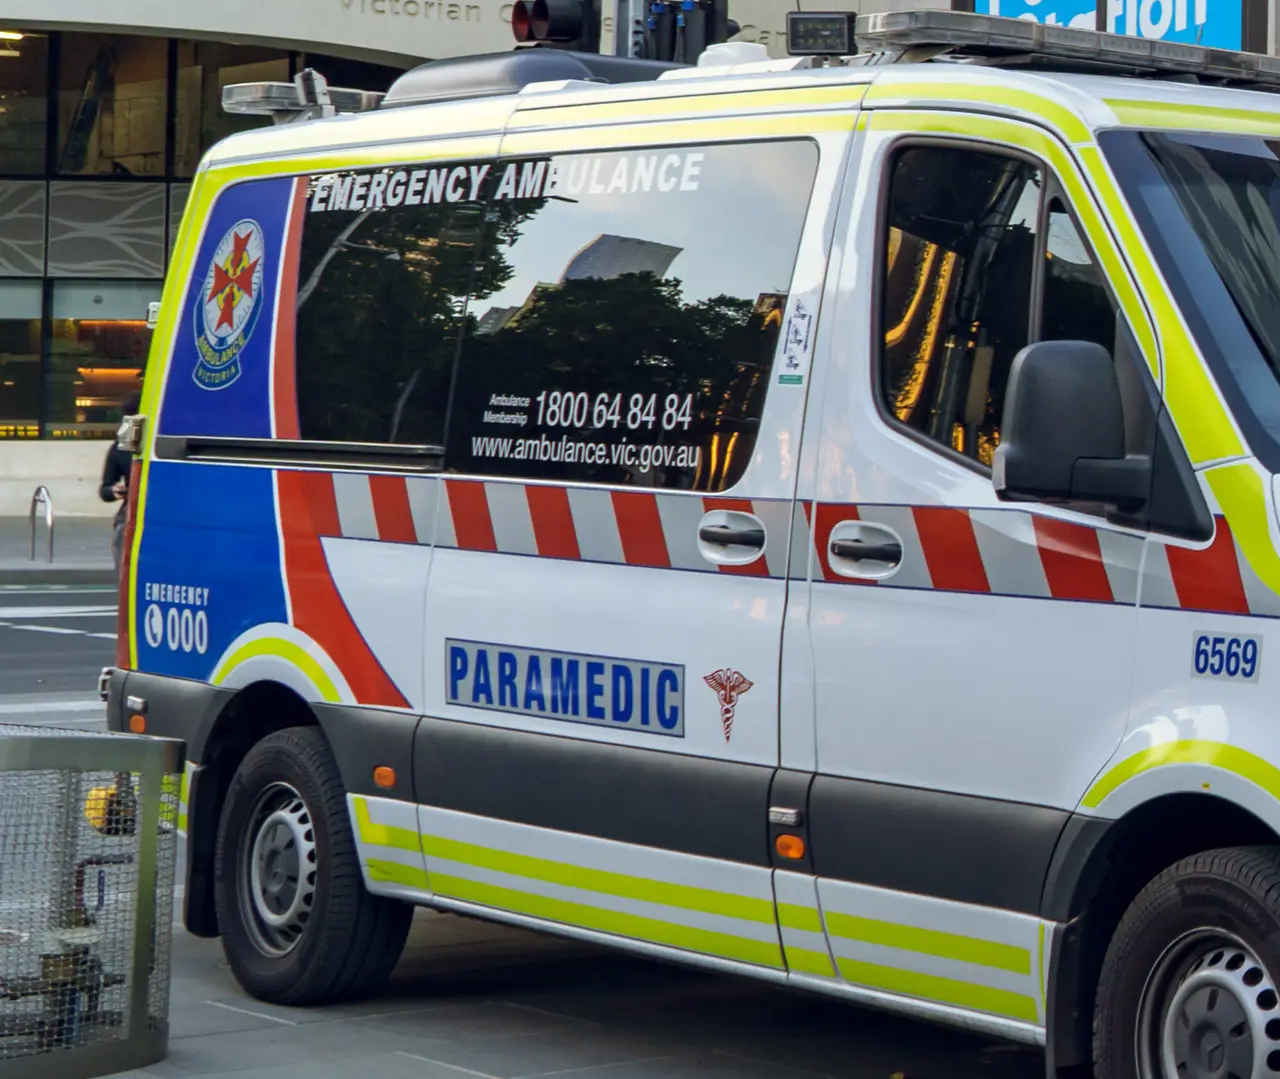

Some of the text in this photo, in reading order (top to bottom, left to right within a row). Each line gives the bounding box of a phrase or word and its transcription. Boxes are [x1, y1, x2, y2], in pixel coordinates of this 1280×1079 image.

[310, 152, 706, 212] EMERGENCY AMBULANCE
[483, 410, 529, 427] Membership
[489, 393, 531, 407] Ambulance
[535, 390, 694, 430] 1800 64 84 84
[471, 434, 701, 473] www.ambulance.vic.gov.au
[145, 582, 210, 607] EMERGENCY
[166, 607, 208, 655] 000
[1194, 635, 1258, 678] 6569
[449, 645, 679, 730] PARAMEDIC
